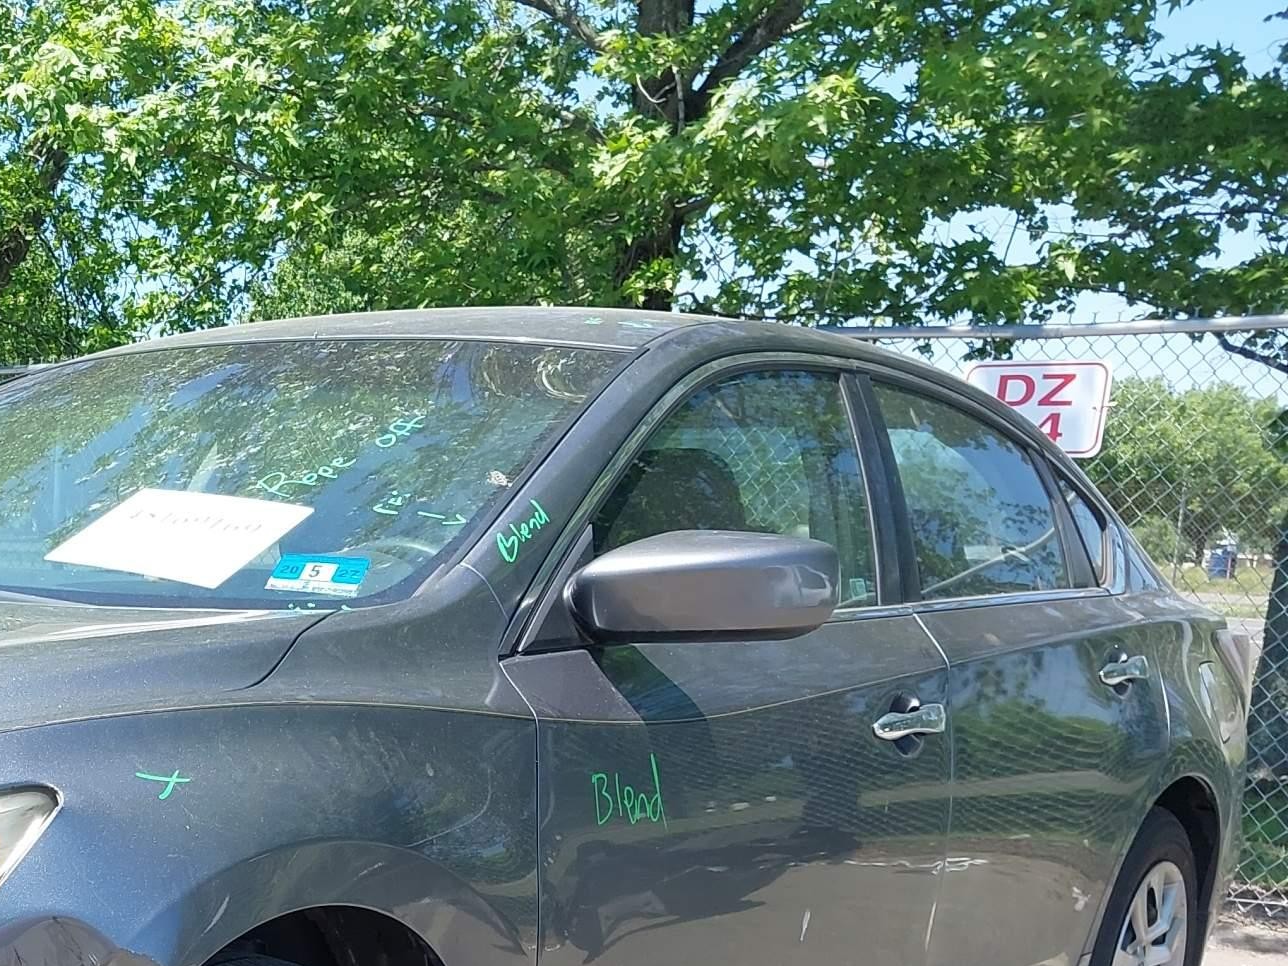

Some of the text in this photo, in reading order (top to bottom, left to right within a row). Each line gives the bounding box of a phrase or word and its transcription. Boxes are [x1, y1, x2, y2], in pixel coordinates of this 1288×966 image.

[997, 374, 1076, 406] DZ
[1039, 413, 1062, 442] 4
[257, 456, 356, 497] Rope
[496, 498, 550, 563] Blend
[280, 565, 299, 574] 20
[308, 565, 323, 578] 5
[592, 753, 668, 832] Blend
